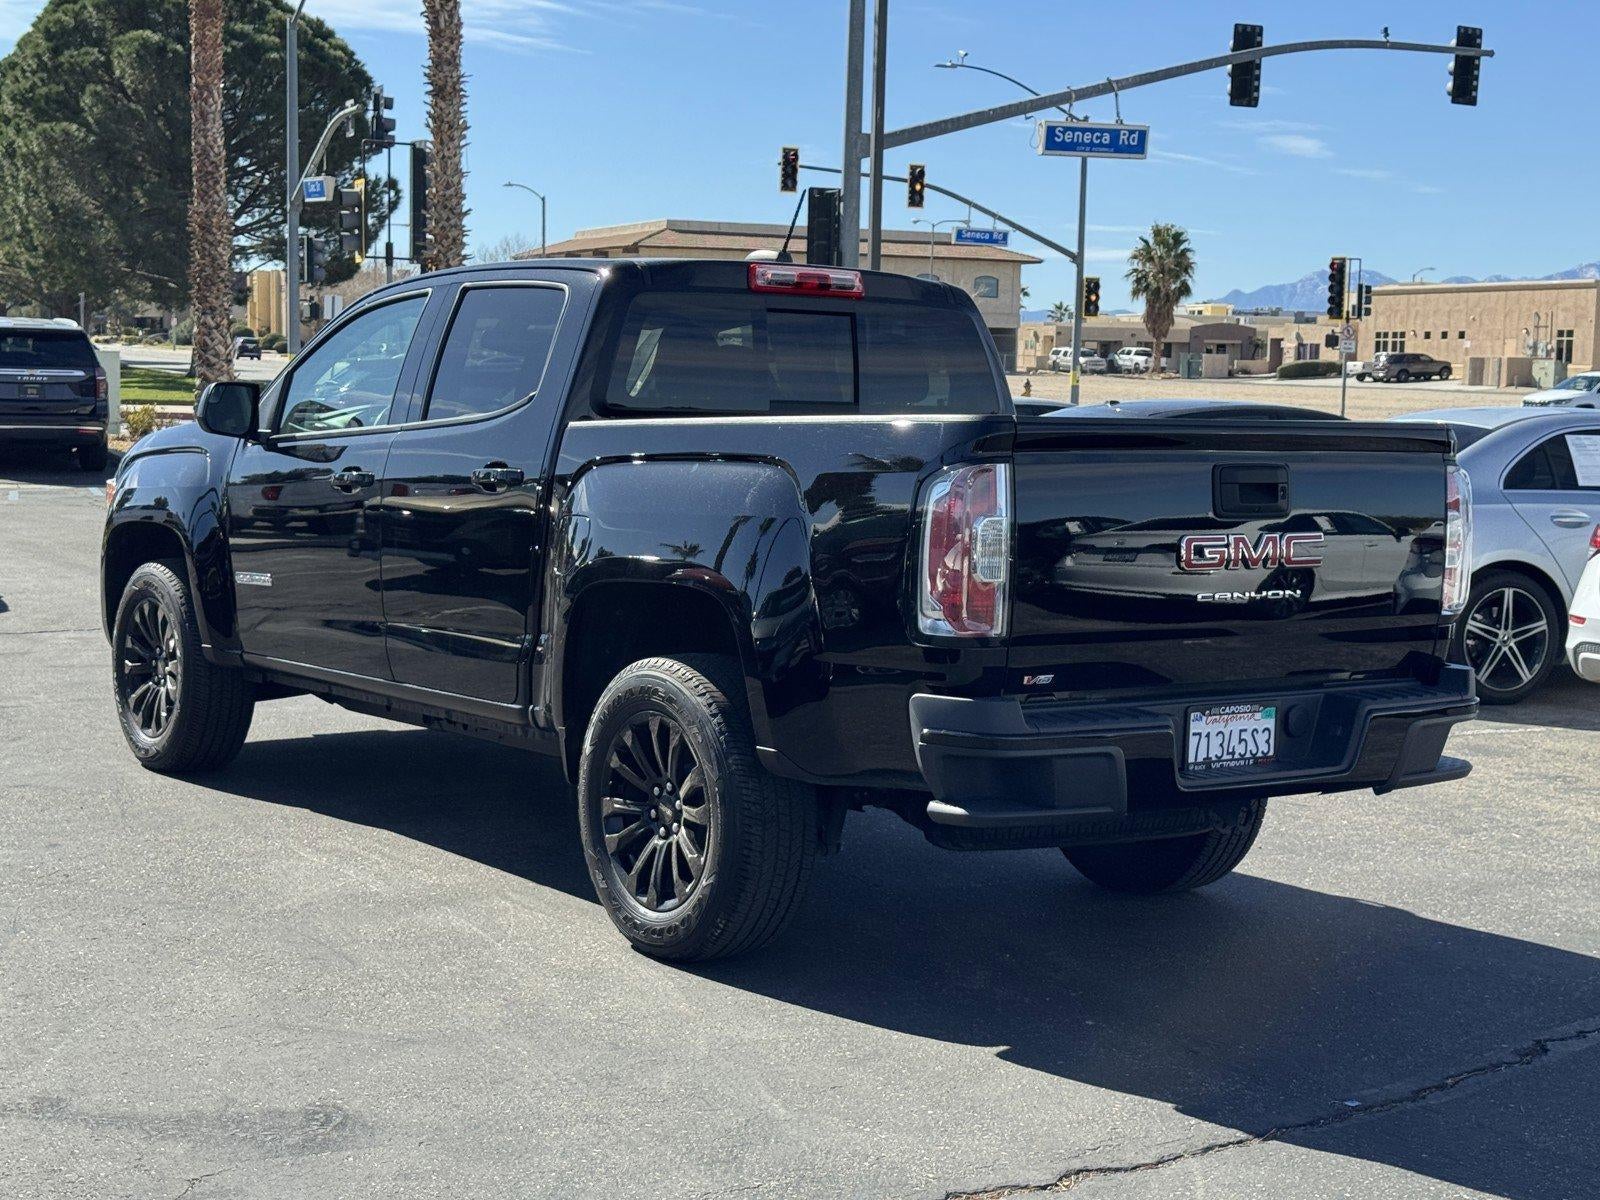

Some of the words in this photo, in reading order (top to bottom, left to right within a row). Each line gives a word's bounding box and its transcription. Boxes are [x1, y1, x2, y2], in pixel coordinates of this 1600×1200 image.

[1054, 126, 1111, 144] Seneca
[1118, 130, 1139, 146] Rd
[961, 230, 990, 240] Seneca
[992, 231, 1004, 241] Rd
[1177, 532, 1325, 571] GMC
[1196, 589, 1302, 603] CANYON
[1023, 674, 1055, 685] V6
[1191, 728, 1272, 763] 71345S3
